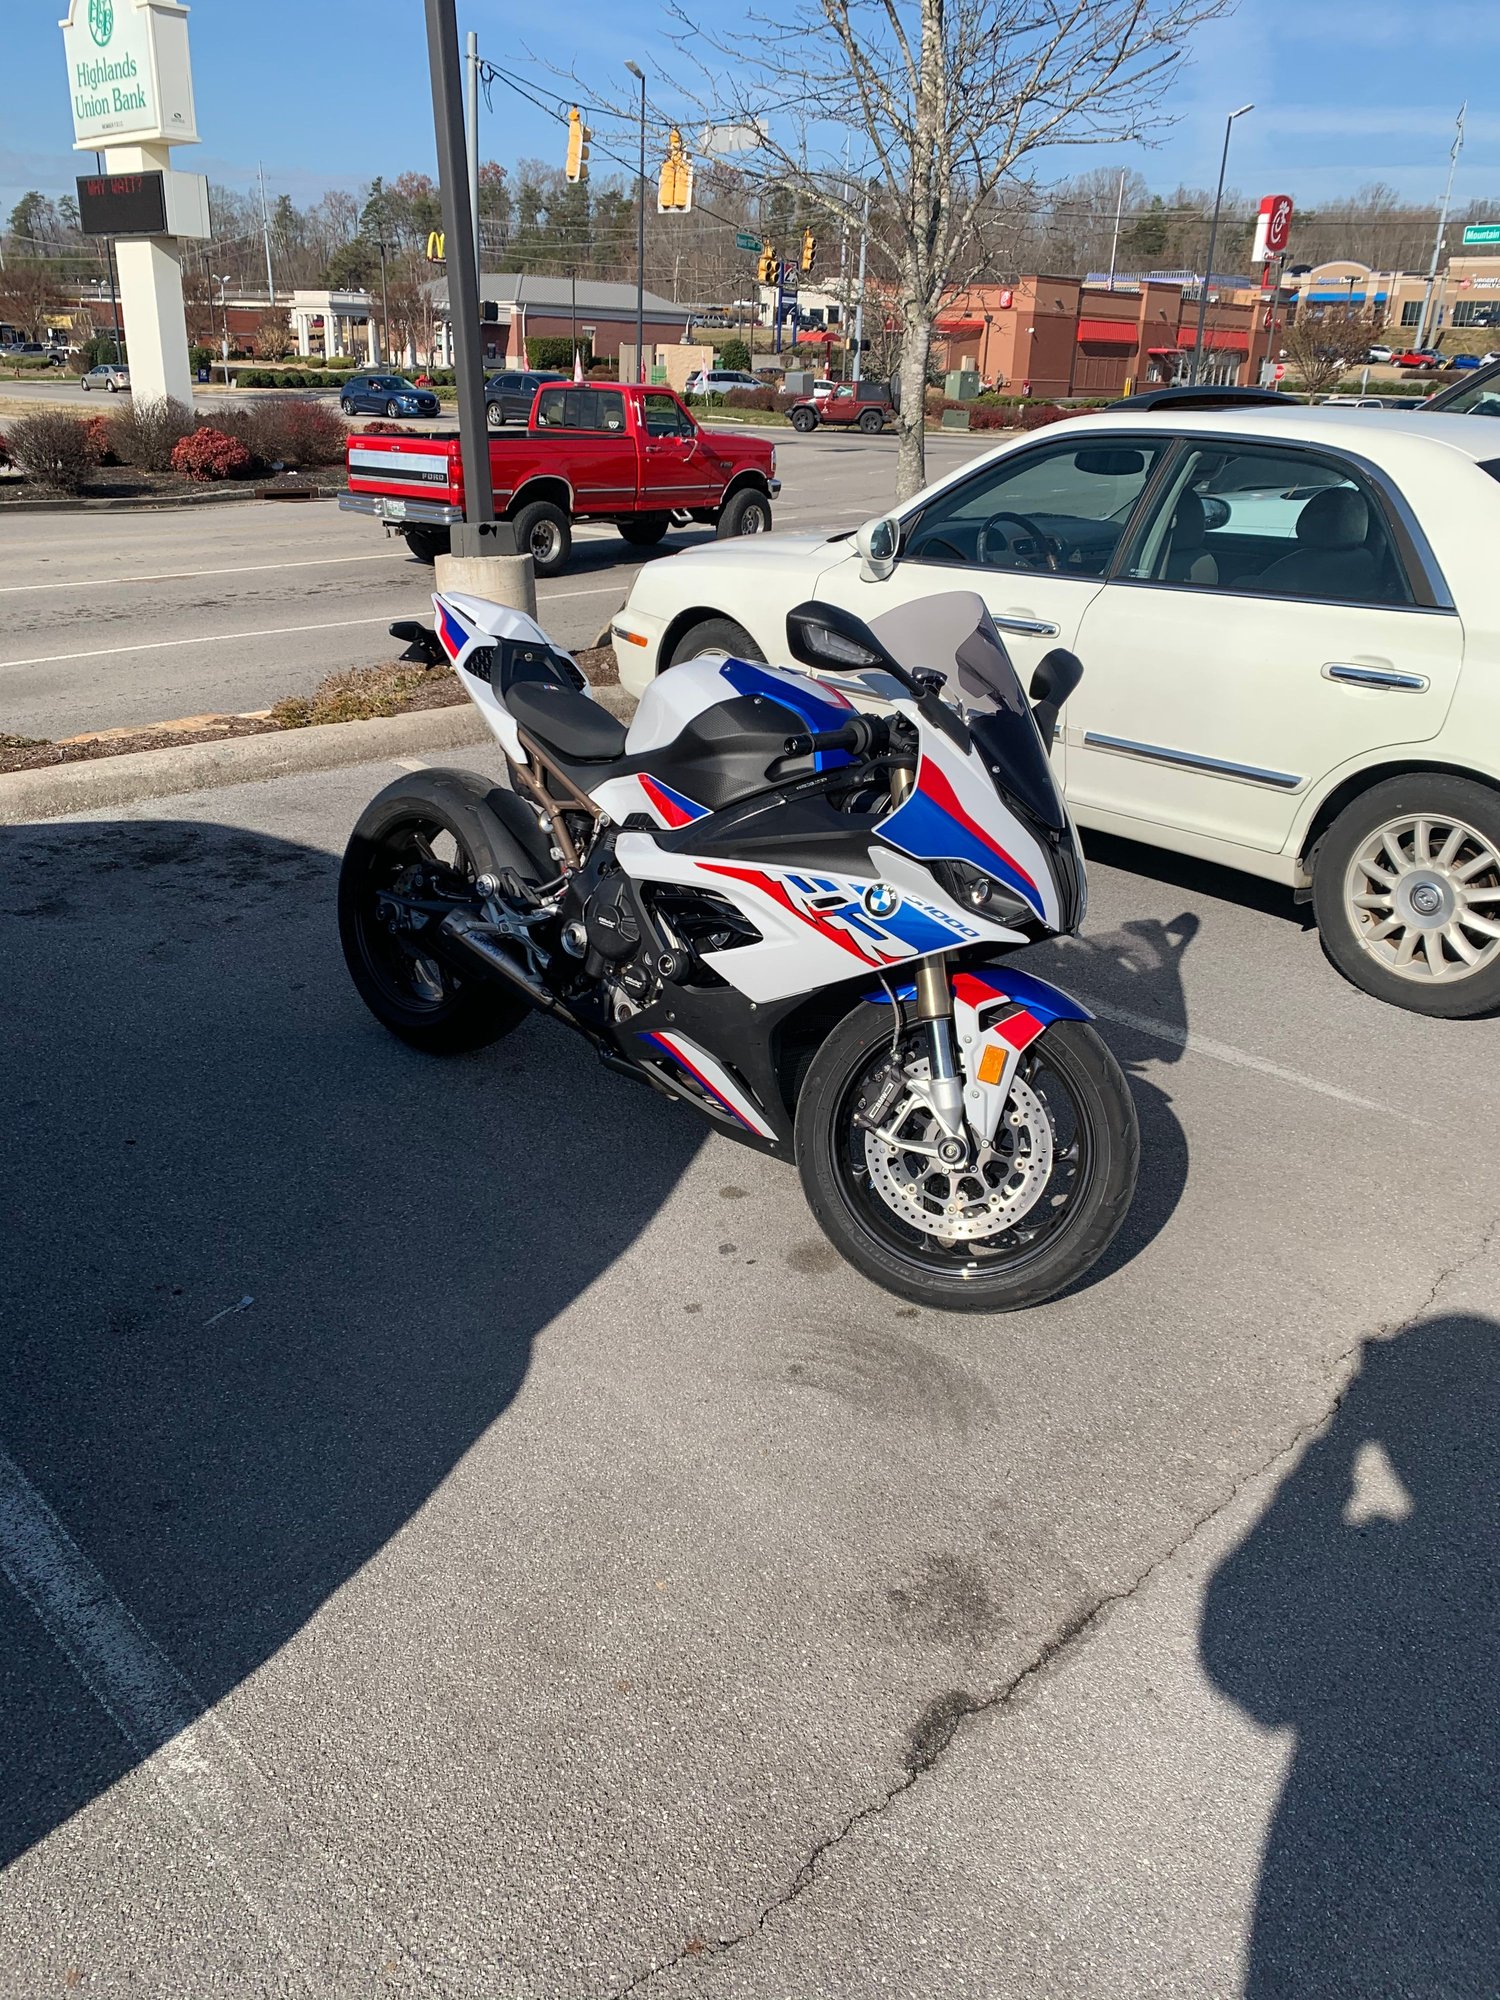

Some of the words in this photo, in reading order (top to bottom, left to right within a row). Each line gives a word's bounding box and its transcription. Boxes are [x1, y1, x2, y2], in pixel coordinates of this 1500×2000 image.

[76, 51, 137, 91] Highlands
[74, 93, 111, 119] Union
[111, 83, 147, 112] Bank
[111, 176, 142, 194] WAIT?
[1466, 230, 1500, 240] Mountain
[421, 472, 444, 481] FORD
[904, 894, 981, 938] S1000
